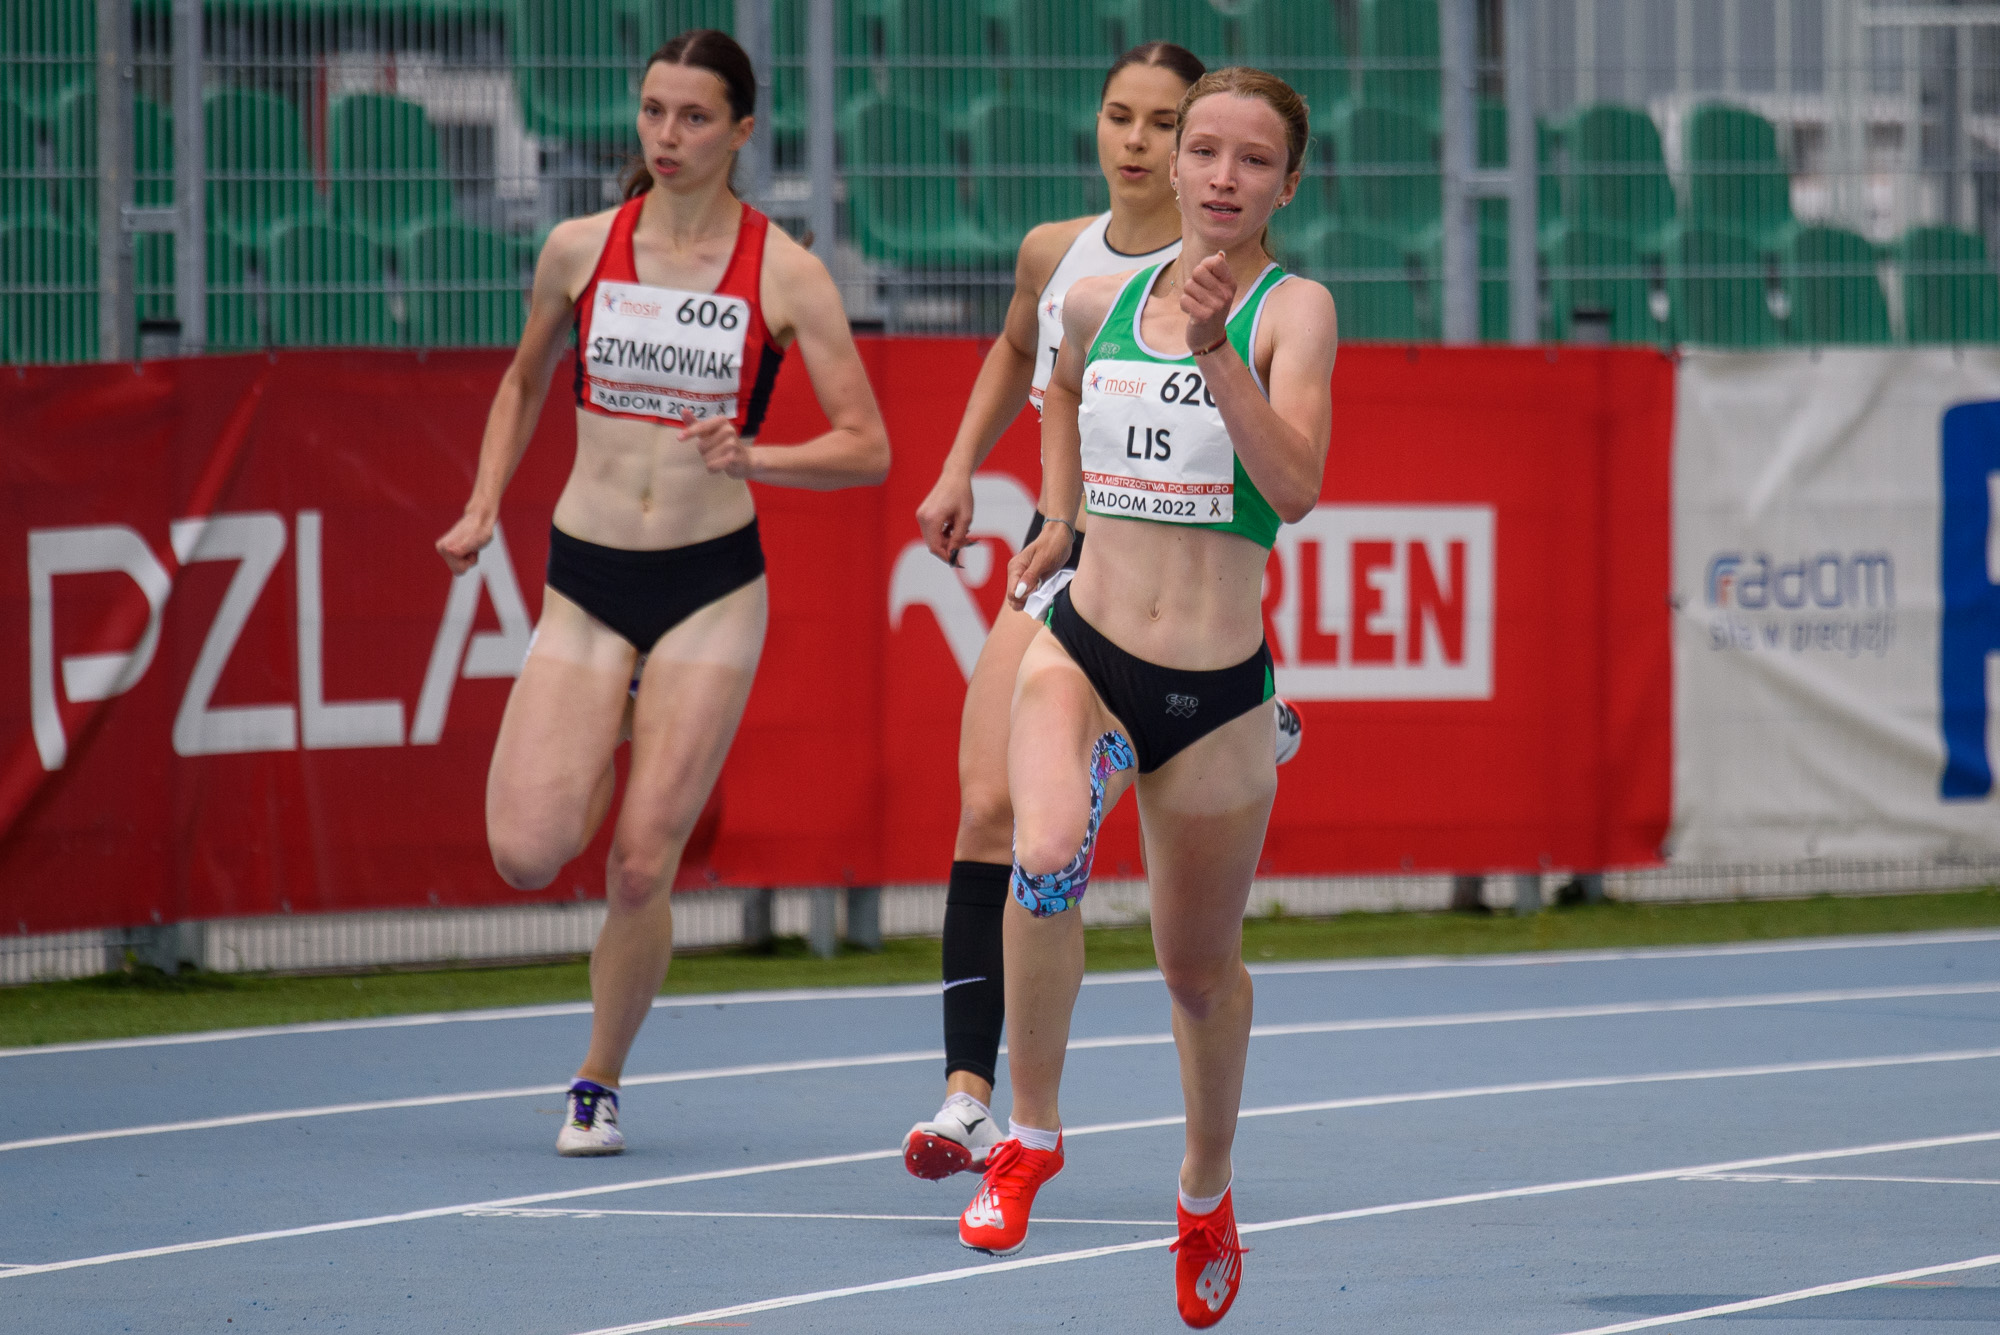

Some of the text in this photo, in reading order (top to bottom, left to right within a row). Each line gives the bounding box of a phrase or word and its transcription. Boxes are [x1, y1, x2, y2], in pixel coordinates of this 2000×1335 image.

[619, 300, 663, 319] mosir
[676, 298, 739, 331] 606
[592, 336, 733, 379] SZYMKOWIAK
[1104, 377, 1147, 395] mosir
[1126, 425, 1172, 462] LIS
[1084, 472, 1230, 494] PZLA MISTRZOSTWA POLSKI U20
[1090, 489, 1196, 517] RADOM 2022
[1261, 540, 1468, 666] RLEN
[28, 510, 534, 772] PZLA
